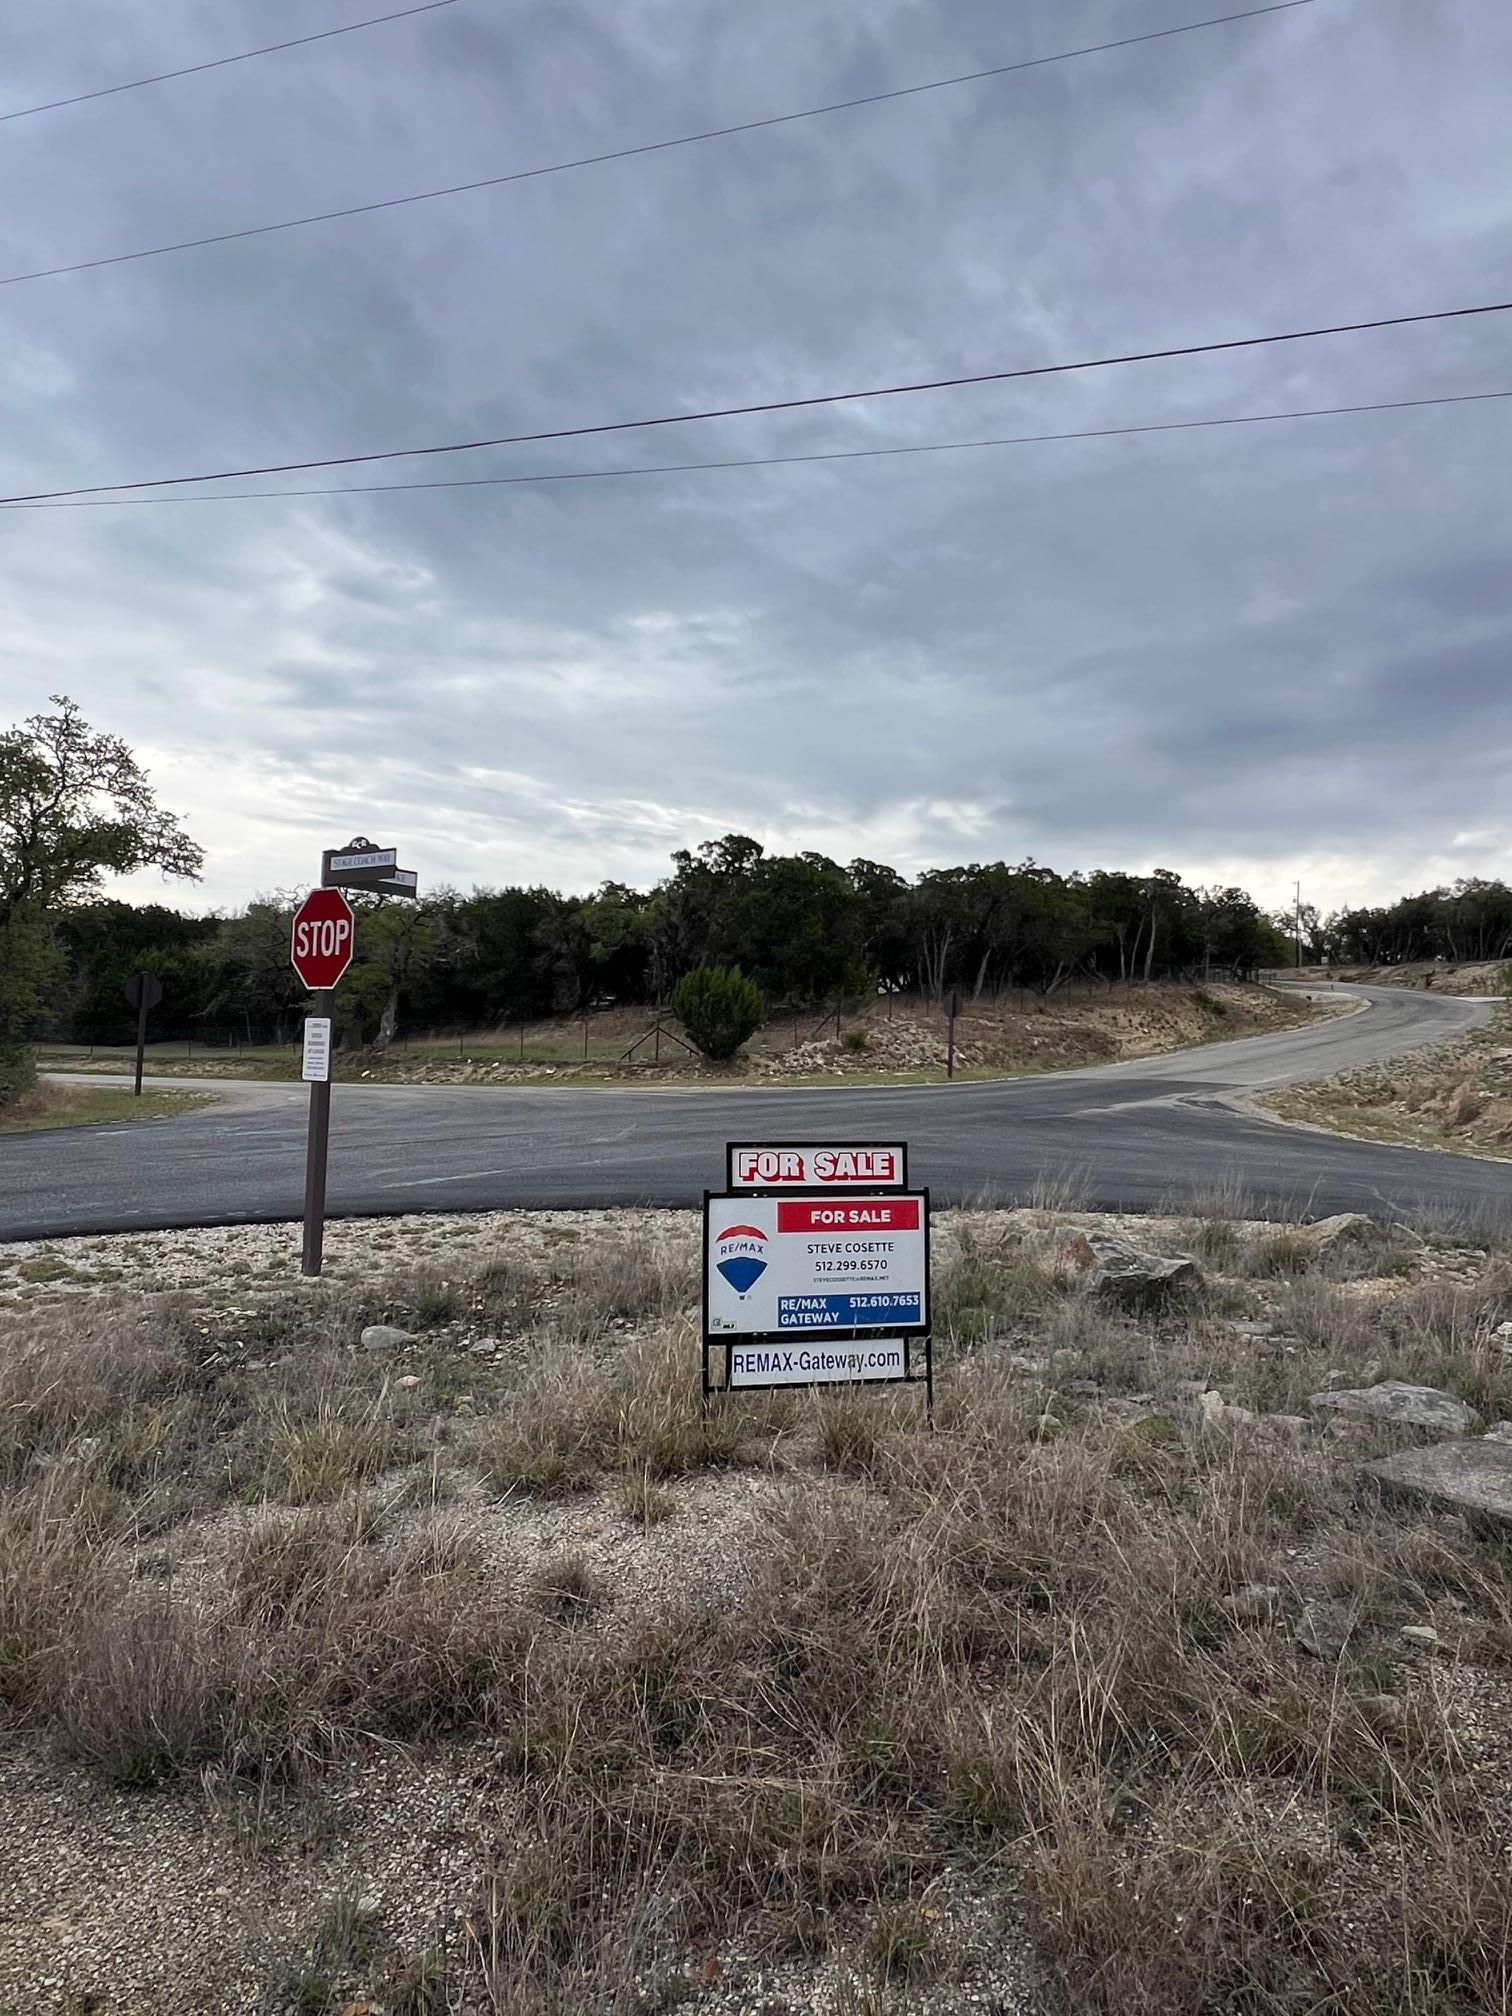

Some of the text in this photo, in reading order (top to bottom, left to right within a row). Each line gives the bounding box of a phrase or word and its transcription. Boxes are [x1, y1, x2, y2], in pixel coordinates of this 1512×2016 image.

[333, 857, 353, 868] STAGE
[354, 854, 376, 866] COACH
[296, 920, 349, 957] STOP
[739, 1152, 894, 1181] FOR SALE
[810, 1210, 891, 1224] FOR SALE
[720, 1243, 764, 1256] RE/MAX
[807, 1242, 894, 1254] STEVE COSETTE
[815, 1260, 888, 1271] 512.299.6570
[781, 1298, 827, 1311] RE/MAX
[849, 1295, 919, 1308] 512.610.7653
[781, 1312, 839, 1325] GATEWAY
[733, 1351, 900, 1374] REMAX-Gateway.com
